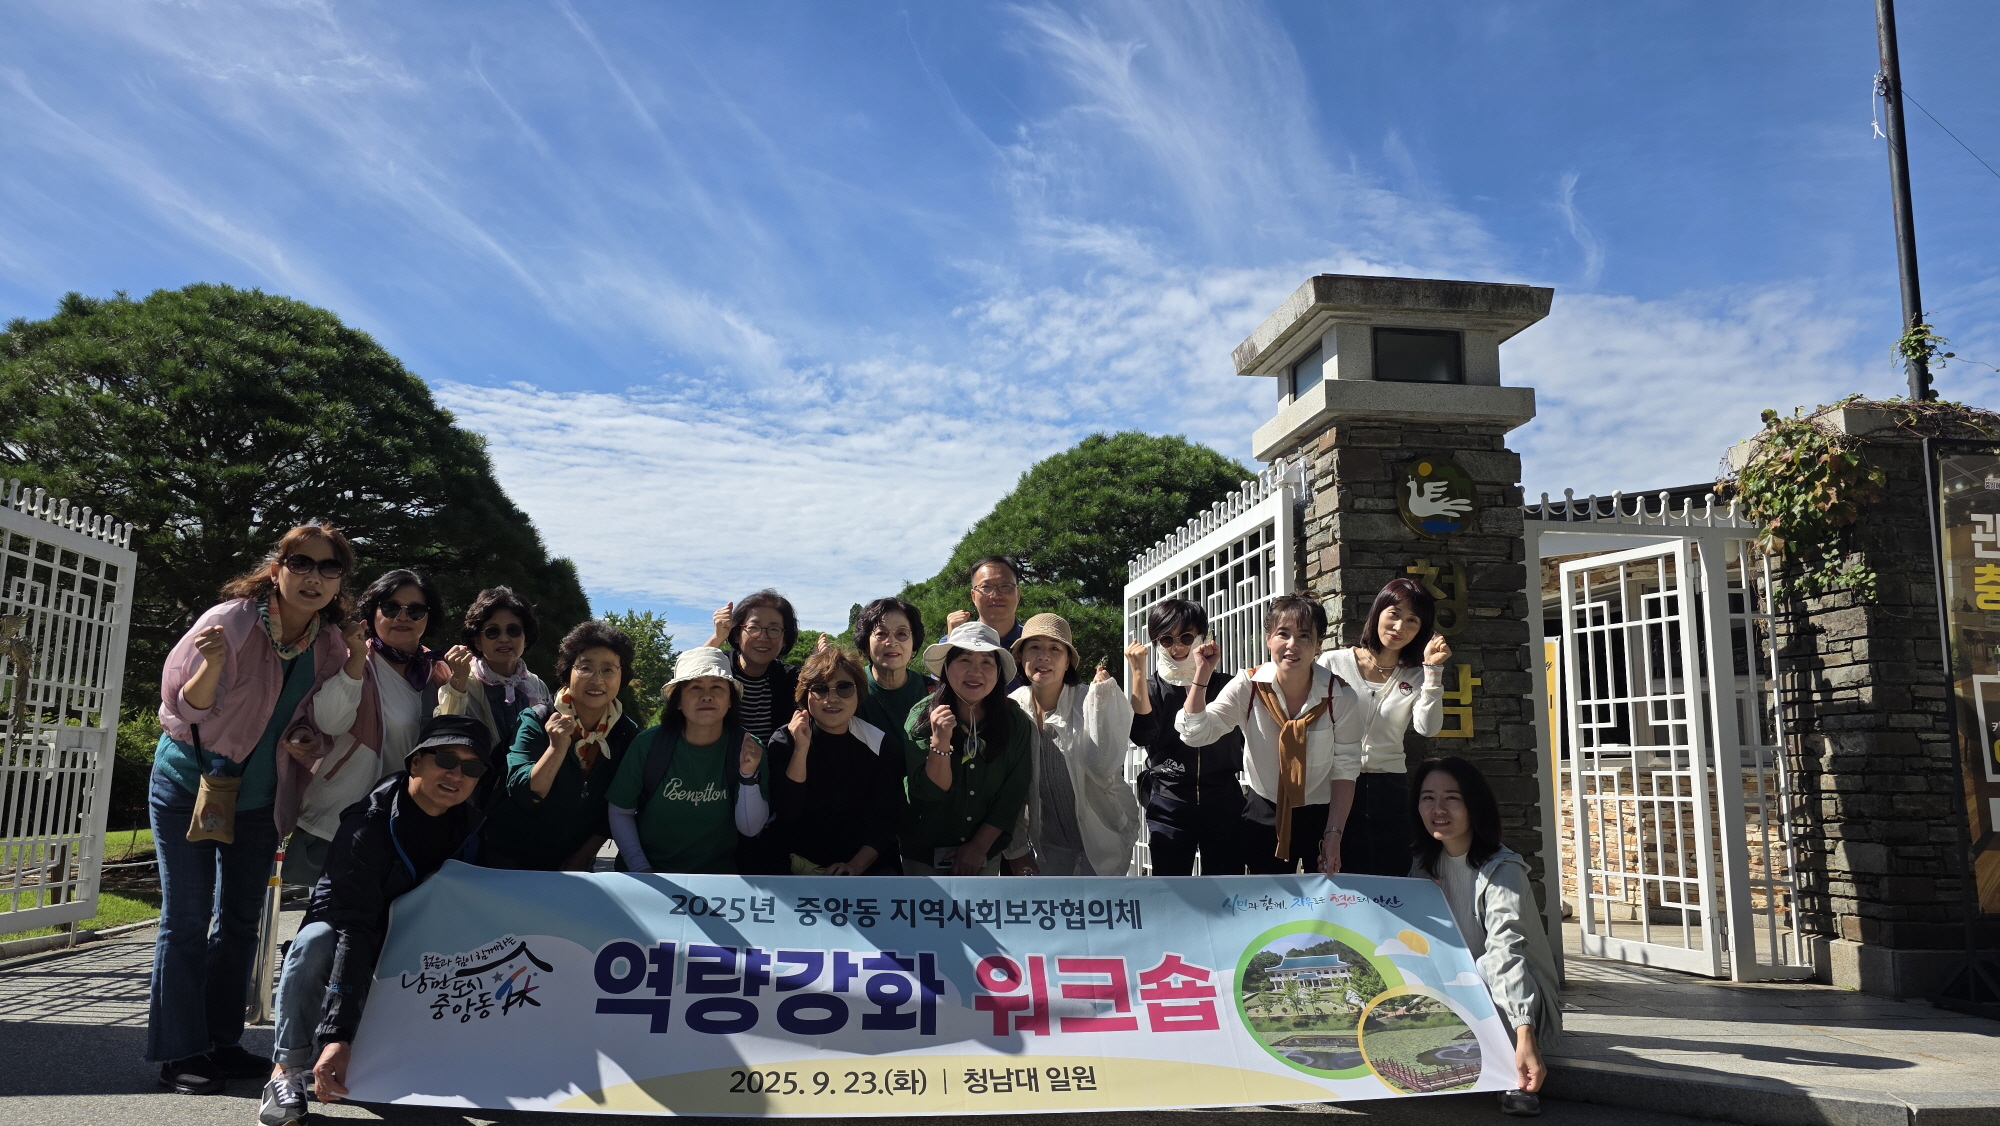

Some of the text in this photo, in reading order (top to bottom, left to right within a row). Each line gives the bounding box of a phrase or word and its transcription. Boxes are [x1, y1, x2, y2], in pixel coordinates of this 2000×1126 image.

[669, 894, 1143, 931] 2025년 중앙동 지역사회보장협의체
[1221, 893, 1258, 916] 시민과
[1290, 896, 1326, 911] 자유로운
[1329, 893, 1370, 909] 혁신도시
[1372, 894, 1405, 909] 안산
[594, 940, 1221, 1036] 역량강화 워크숍
[430, 992, 495, 1023] 중앙동
[729, 1066, 1098, 1097] 2025. 9. 23.(화) 청남대 일원
